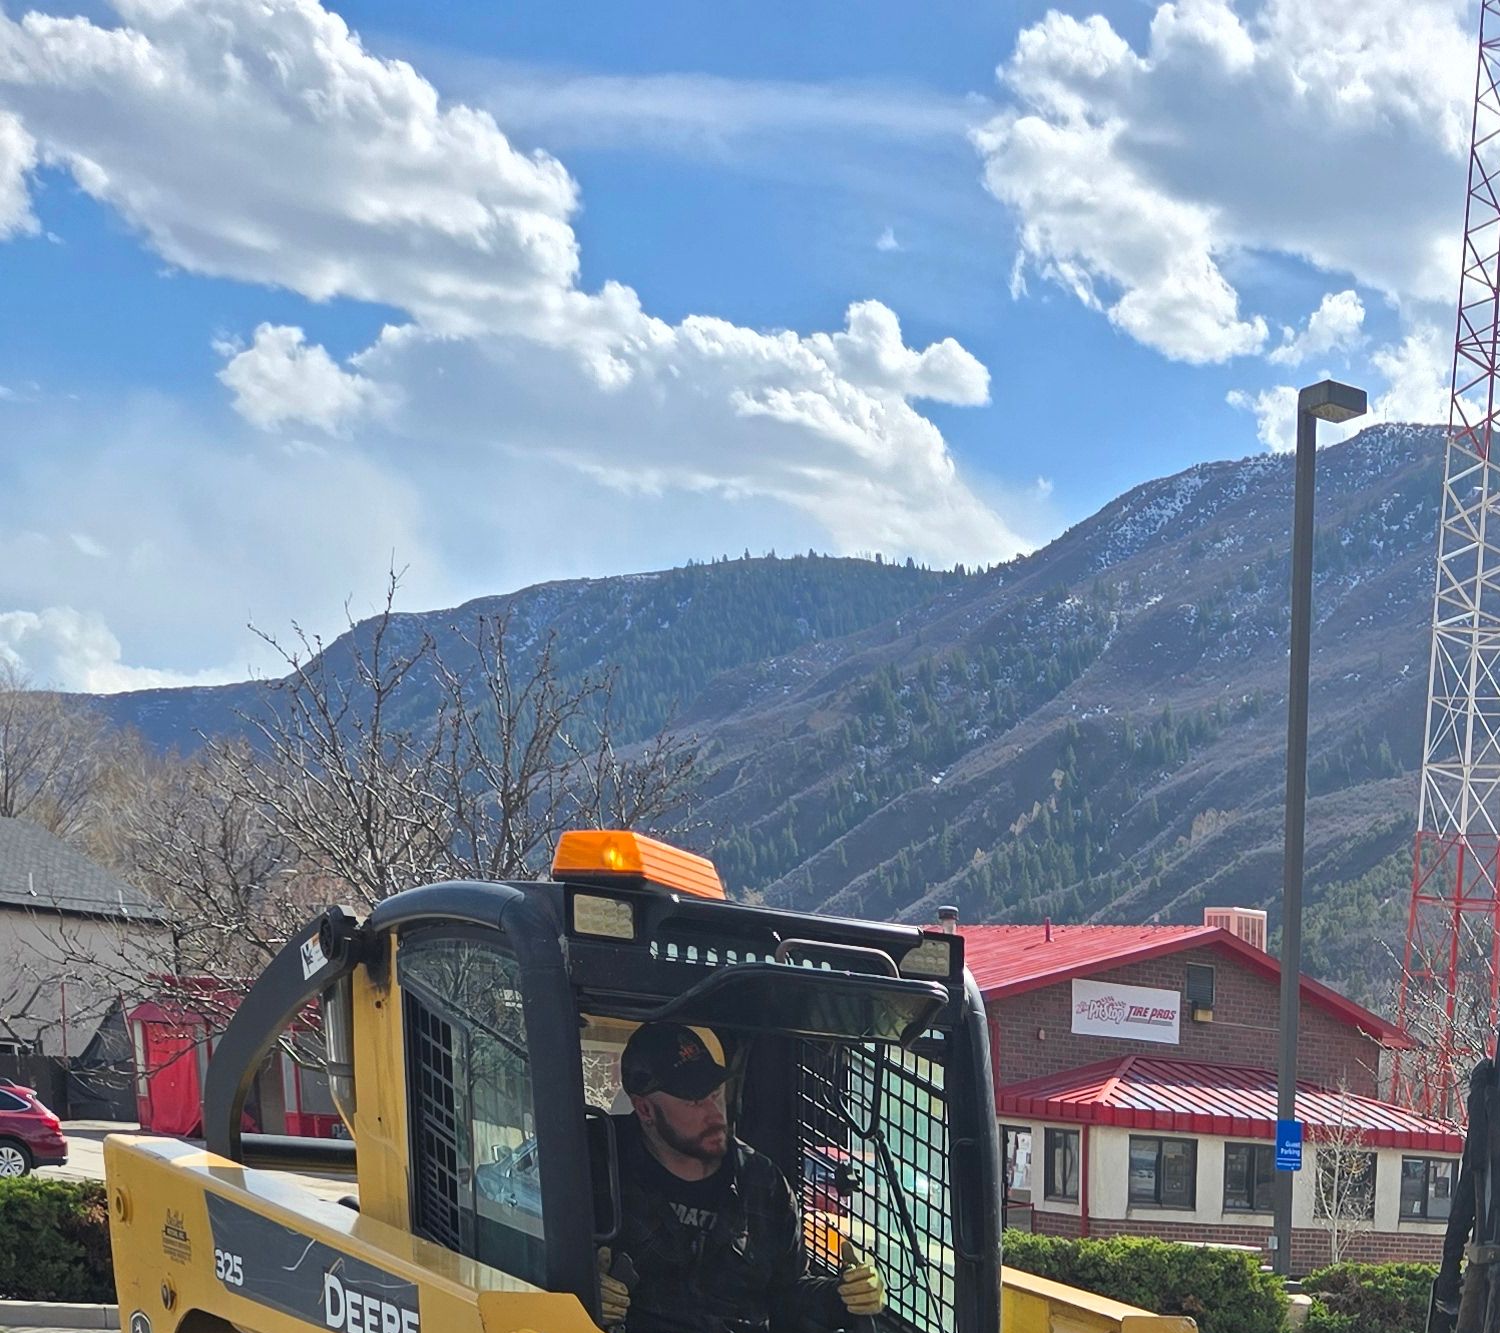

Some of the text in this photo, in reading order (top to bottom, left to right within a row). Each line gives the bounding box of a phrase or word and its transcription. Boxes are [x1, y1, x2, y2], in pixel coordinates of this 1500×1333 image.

[1126, 1005, 1150, 1022] TIRE
[1148, 1008, 1176, 1024] PROS
[1280, 1147, 1300, 1157] Parking
[215, 1249, 244, 1286] 325
